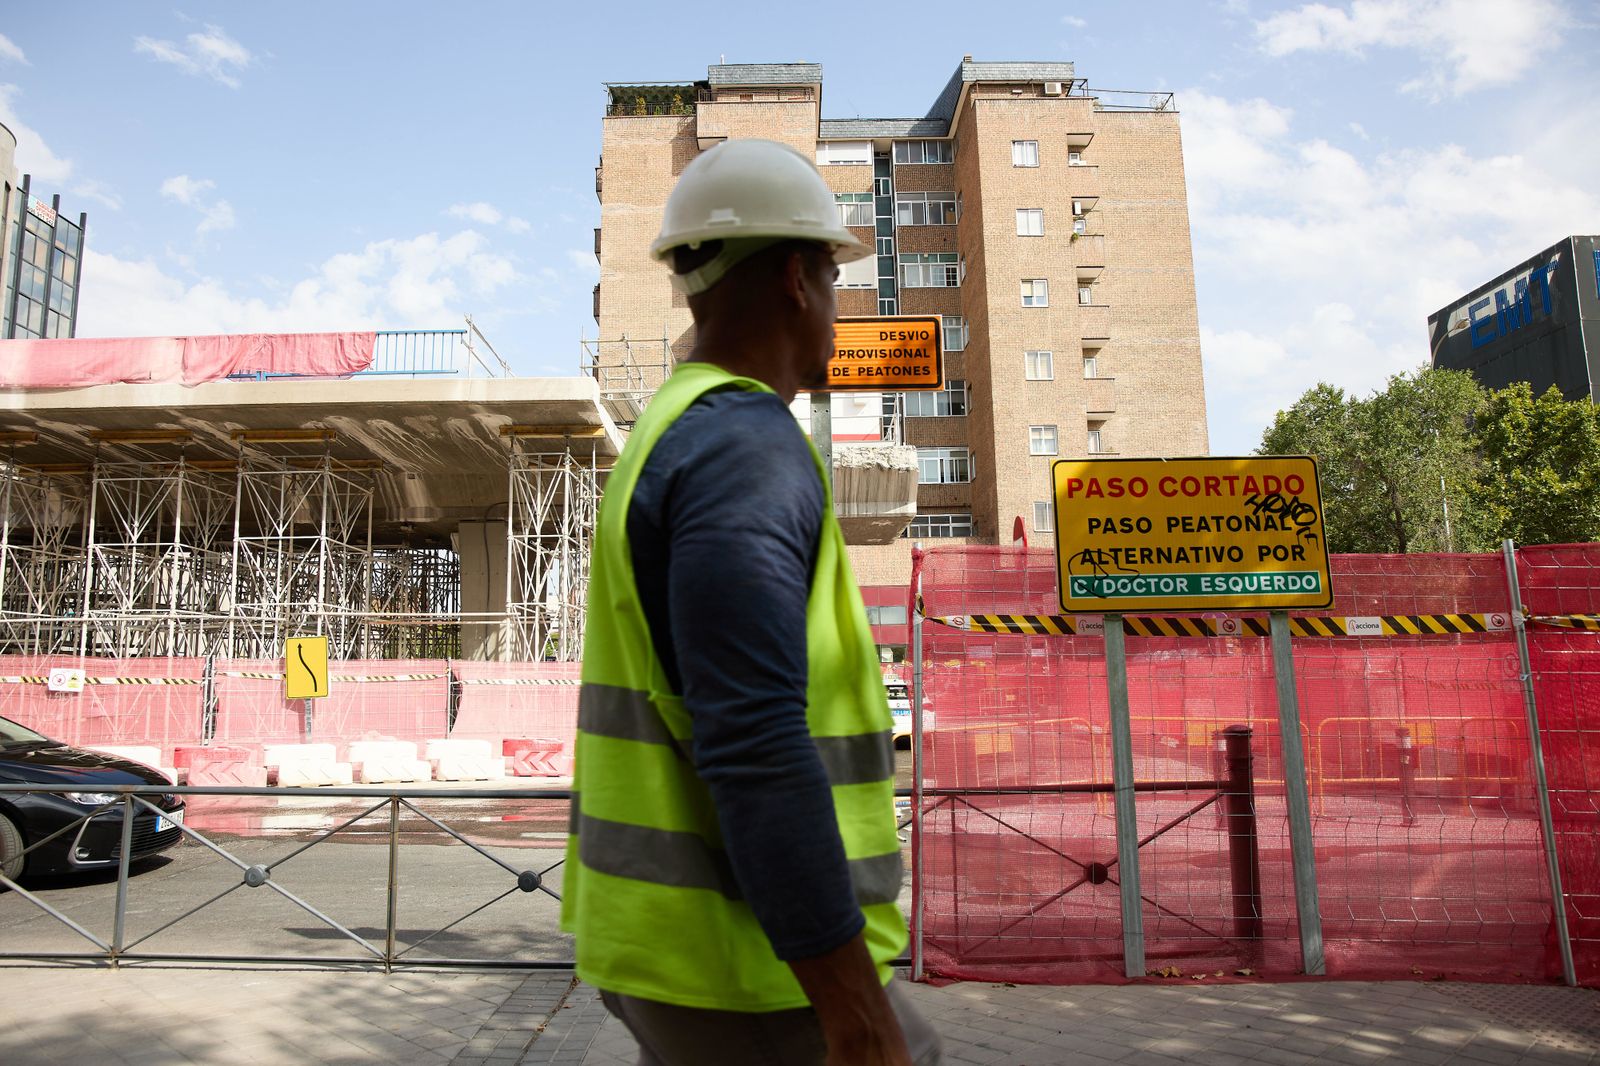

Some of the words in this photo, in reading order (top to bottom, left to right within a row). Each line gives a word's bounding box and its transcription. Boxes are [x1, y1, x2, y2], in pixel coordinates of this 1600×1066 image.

[1468, 260, 1560, 348] EMT
[879, 330, 929, 341] DESVIO
[838, 348, 930, 360] PROVISIONAL
[832, 367, 850, 377] DE
[858, 365, 930, 377] PEATONES
[1067, 476, 1149, 499] PASO
[1158, 474, 1305, 497] CORTADO
[1088, 517, 1152, 535] PASO
[1167, 514, 1293, 533] PEATONAL
[1080, 545, 1244, 566] ALTERNATIVO
[1258, 544, 1306, 562] POR
[1201, 575, 1316, 592] ESQUERDO
